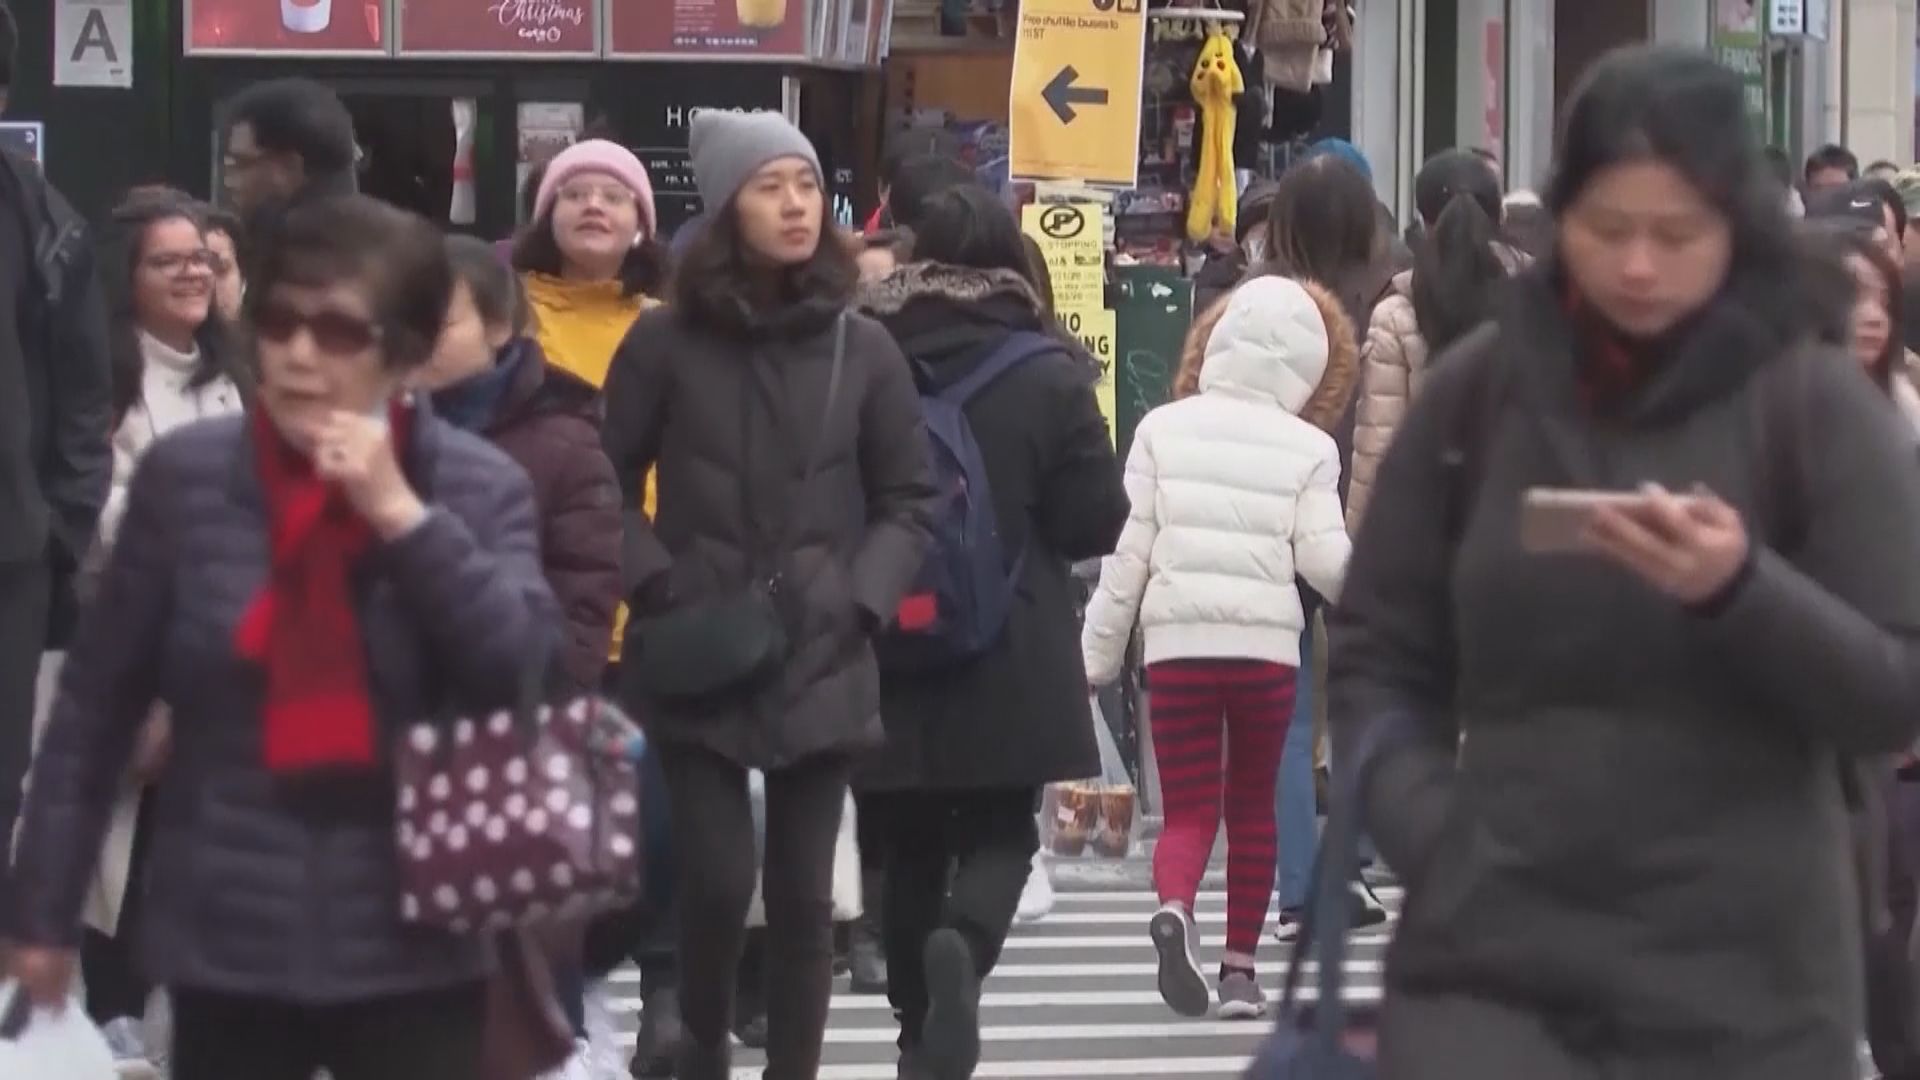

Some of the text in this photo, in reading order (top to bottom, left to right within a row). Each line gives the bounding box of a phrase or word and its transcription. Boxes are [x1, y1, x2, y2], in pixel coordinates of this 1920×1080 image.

[487, 0, 584, 26] Christmas
[1043, 15, 1076, 28] shuttle
[1111, 18, 1119, 30] to
[70, 8, 118, 62] A
